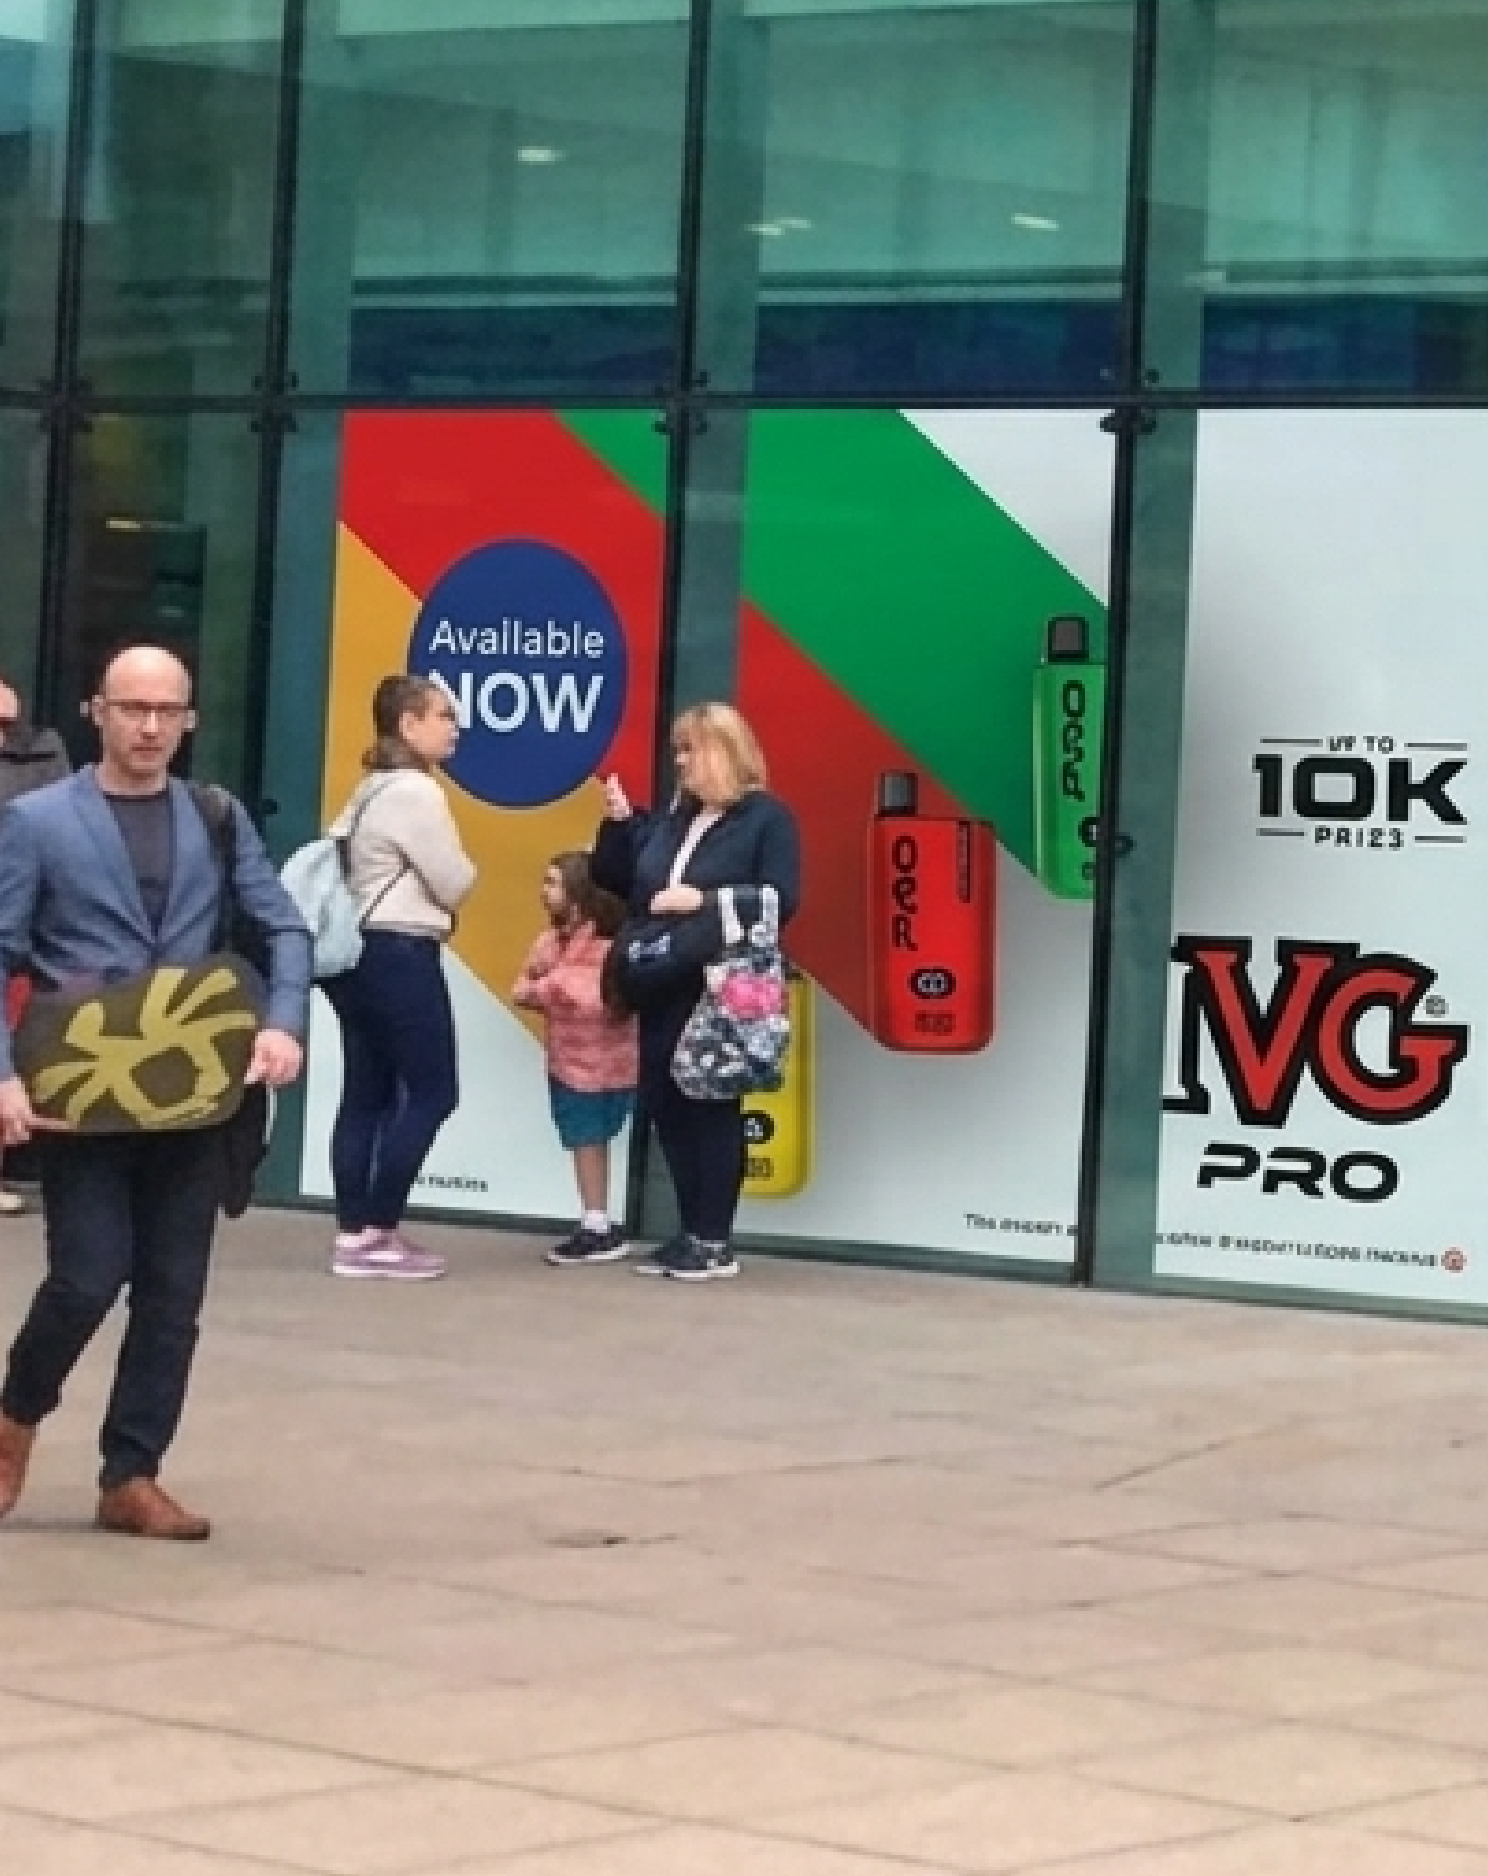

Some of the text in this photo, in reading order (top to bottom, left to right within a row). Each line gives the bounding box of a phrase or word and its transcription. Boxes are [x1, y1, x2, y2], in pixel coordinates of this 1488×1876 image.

[429, 616, 604, 658] Available
[429, 669, 604, 733] NOW
[1252, 753, 1468, 825] 10K
[1196, 1140, 1400, 1203] PRO
